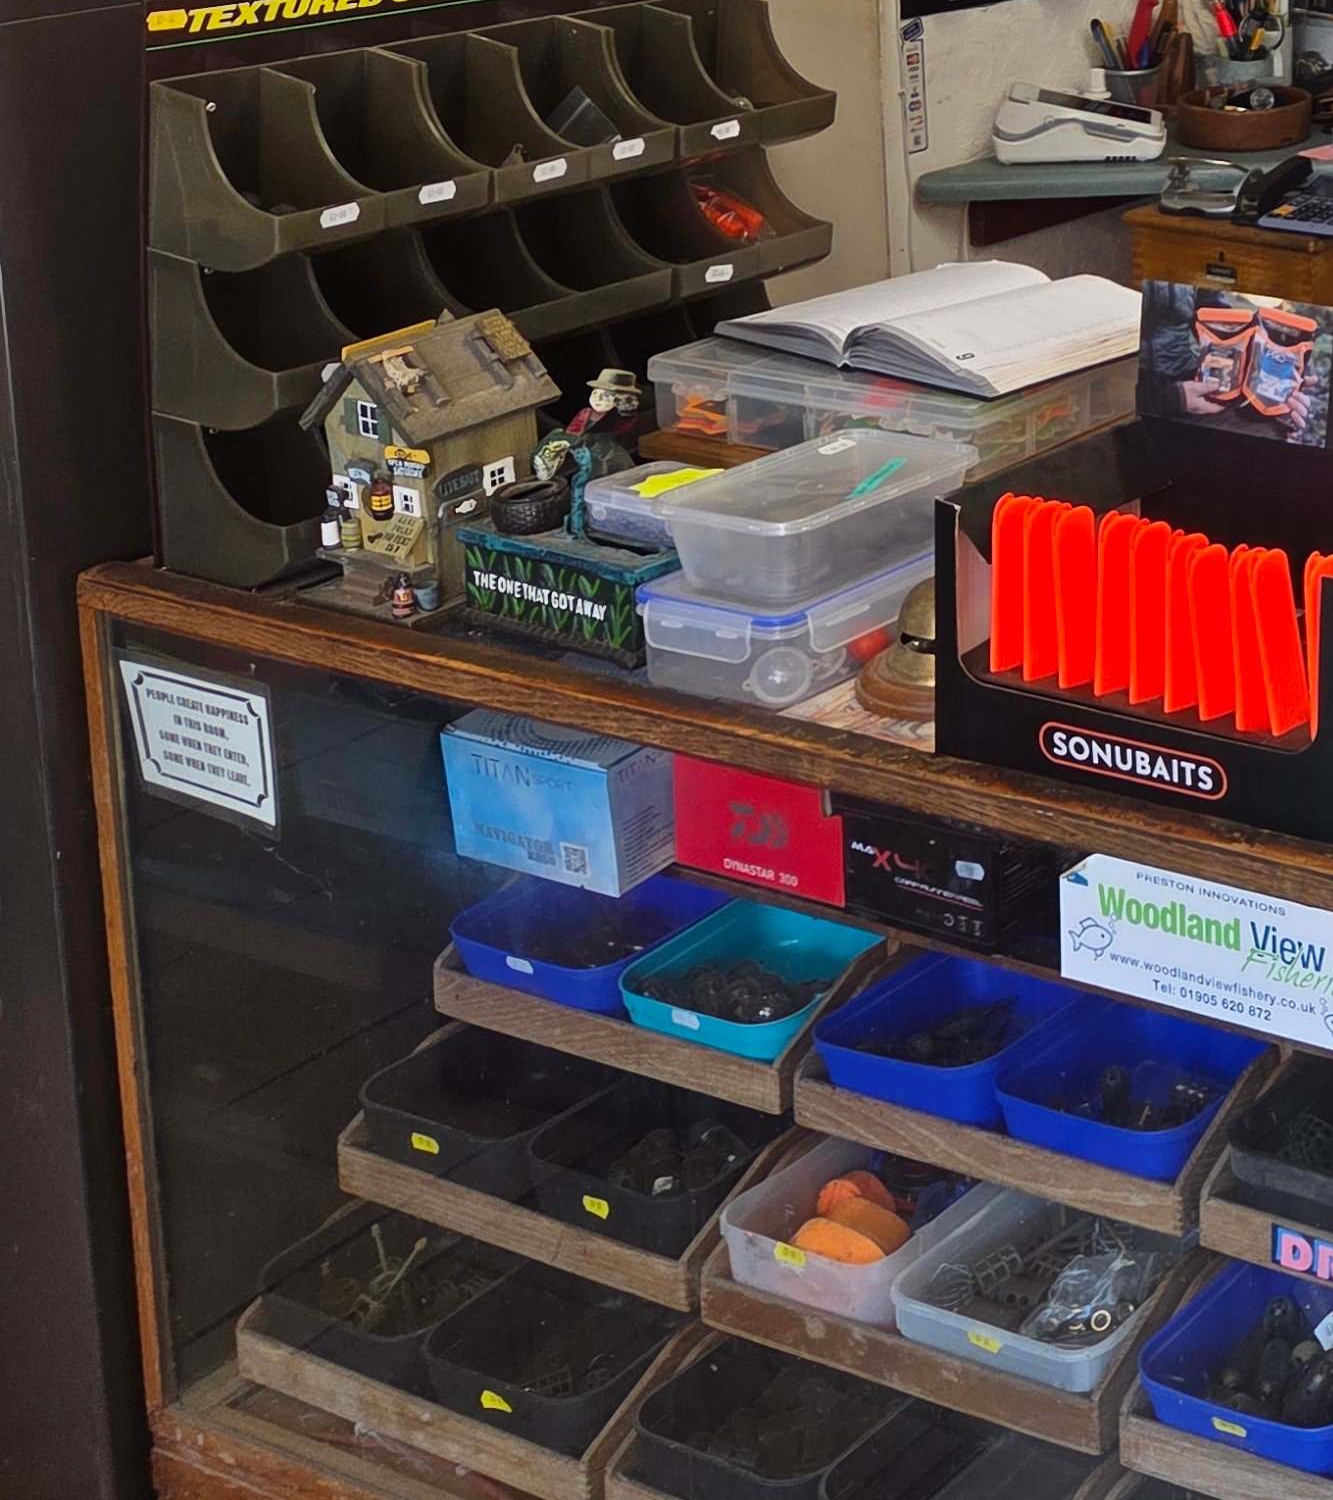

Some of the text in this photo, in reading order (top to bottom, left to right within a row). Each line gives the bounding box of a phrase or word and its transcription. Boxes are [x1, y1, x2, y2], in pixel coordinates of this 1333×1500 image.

[473, 570, 607, 621] THE ONE THAT GOT AWAY
[173, 714, 184, 726] IN
[205, 702, 249, 726] HAPPINESS
[470, 753, 531, 787] TITAN
[1052, 731, 1214, 791] SONUBAITS
[723, 857, 775, 881] DYNASTAR
[1136, 871, 1286, 917] PRESTON INNOVATIONS
[1096, 883, 1326, 972] Woodland View
[1152, 979, 1273, 1022] Tel: 01905 620 872
